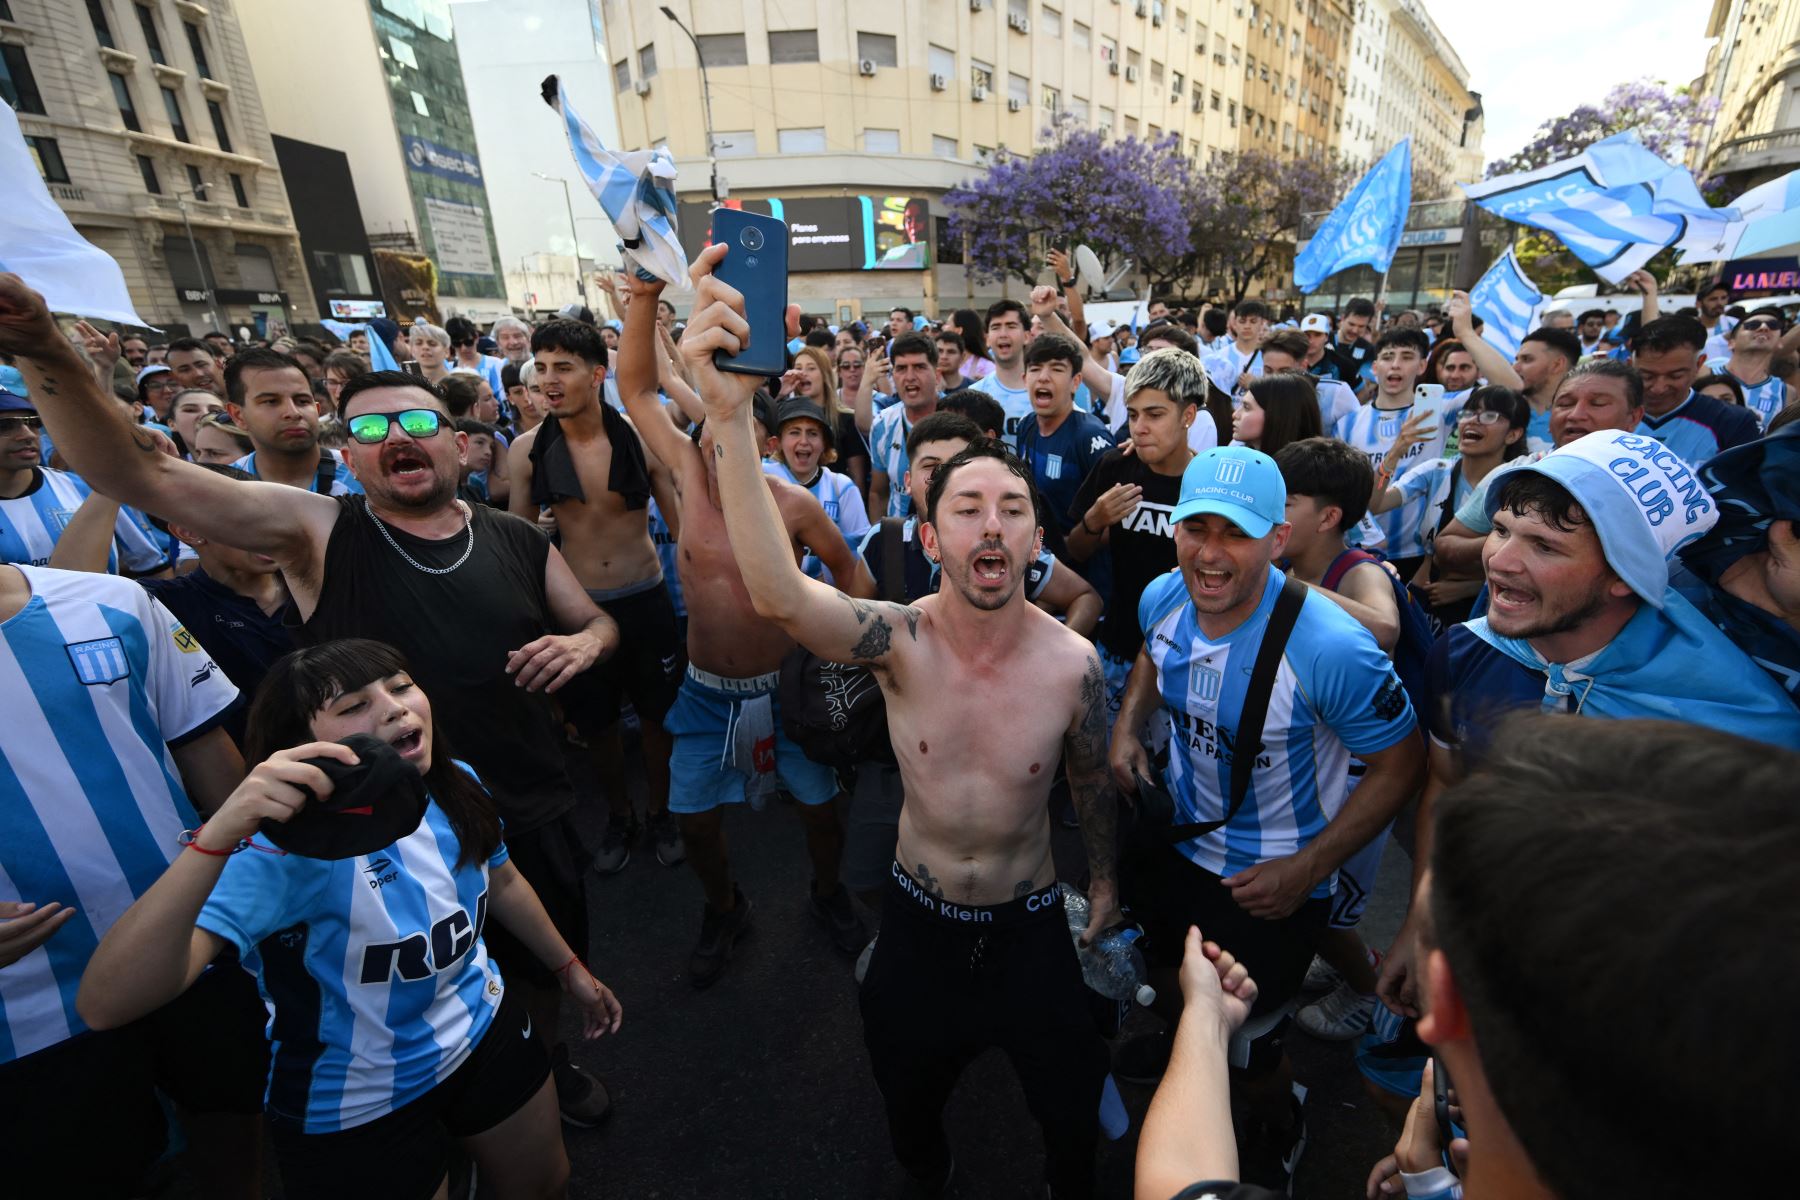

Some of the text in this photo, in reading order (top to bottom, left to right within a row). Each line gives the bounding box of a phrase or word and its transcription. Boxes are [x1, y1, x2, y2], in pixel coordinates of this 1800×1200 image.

[791, 223, 818, 233] Planes
[792, 234, 850, 246] para empresas
[1733, 272, 1755, 289] LA
[258, 292, 281, 303] BBVA
[1611, 435, 1710, 525] RACING
[1195, 486, 1254, 504] RACING CLUB
[1608, 457, 1675, 527] CLUB
[74, 640, 118, 654] RACING
[892, 860, 935, 911] Calvin
[940, 902, 993, 923] Klein
